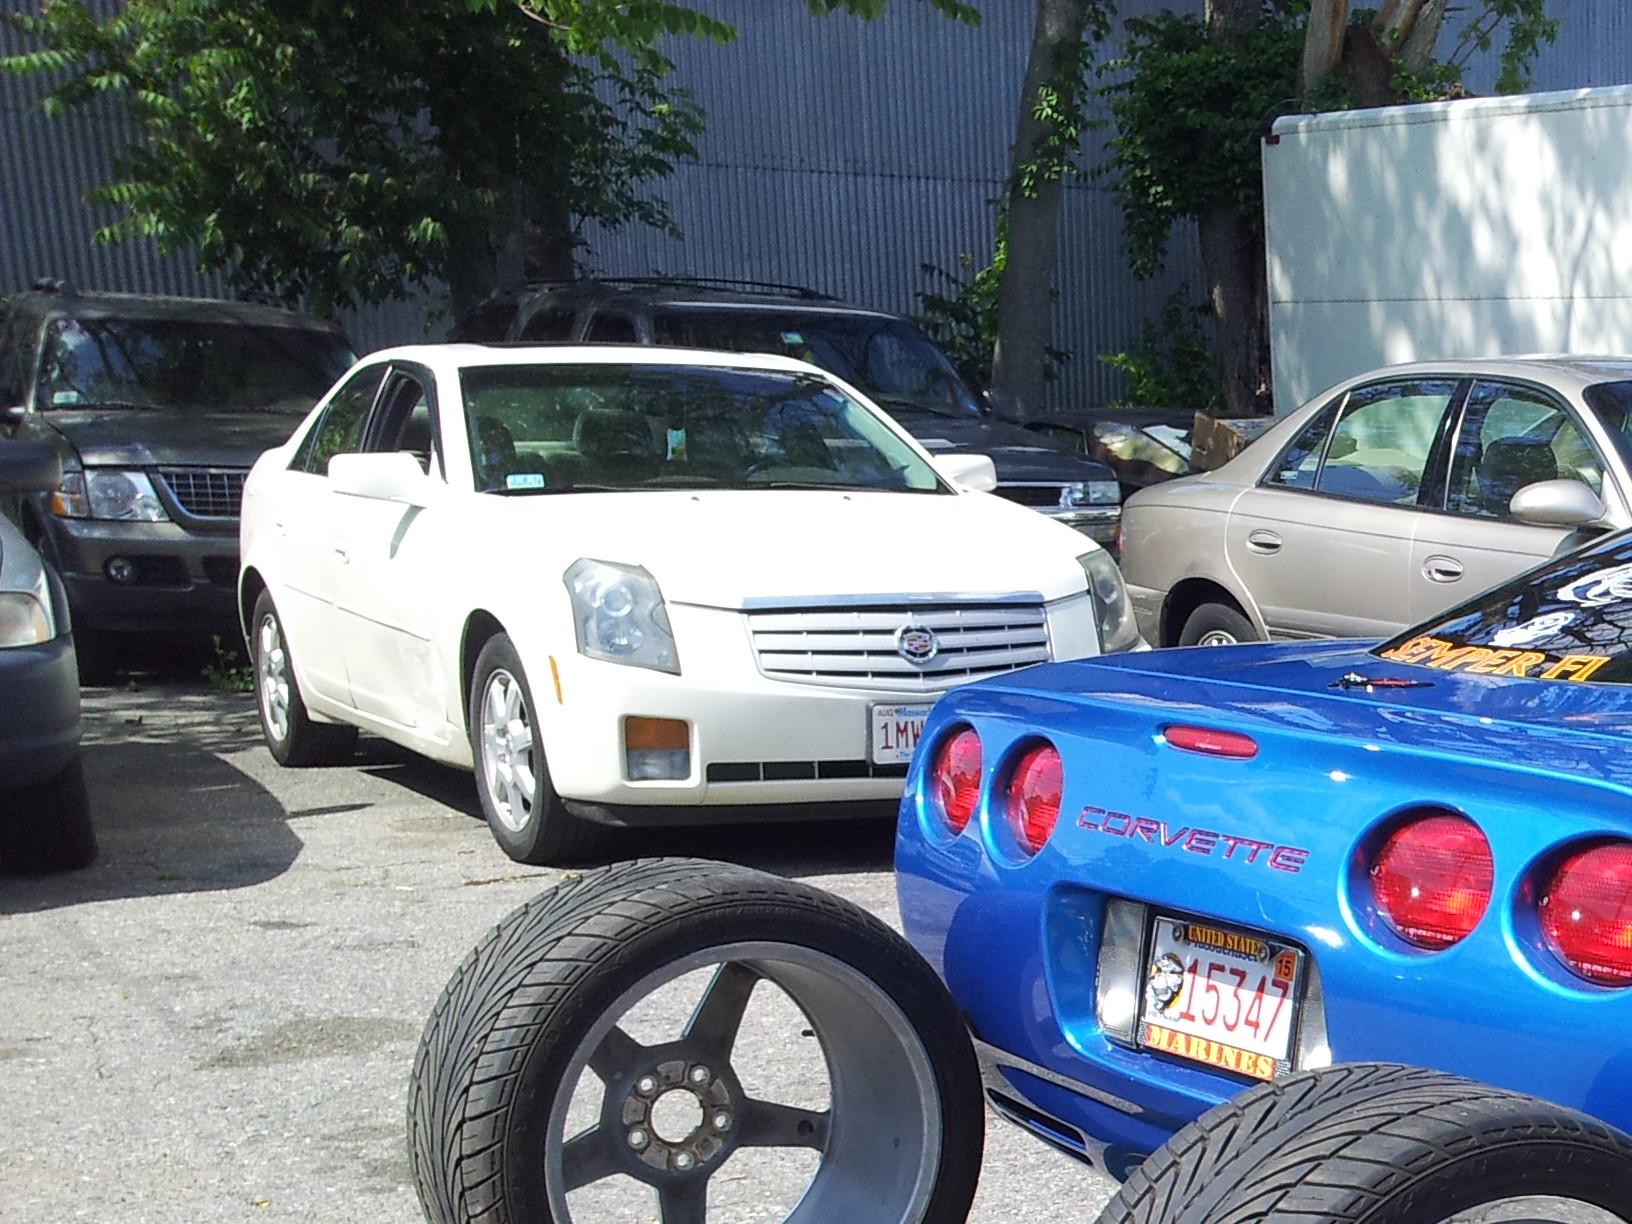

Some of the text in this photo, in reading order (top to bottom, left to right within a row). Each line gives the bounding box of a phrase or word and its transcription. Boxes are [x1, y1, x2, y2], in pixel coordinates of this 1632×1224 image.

[1380, 636, 1611, 682] SEMPER FI
[878, 708, 894, 717] AUG
[1076, 805, 1311, 874] CORVETTE
[1188, 924, 1225, 947] UNITED
[1226, 931, 1262, 957] STATE
[1278, 958, 1291, 977] 15
[1180, 958, 1290, 1043] 15347
[1149, 1024, 1273, 1079] MARINES
